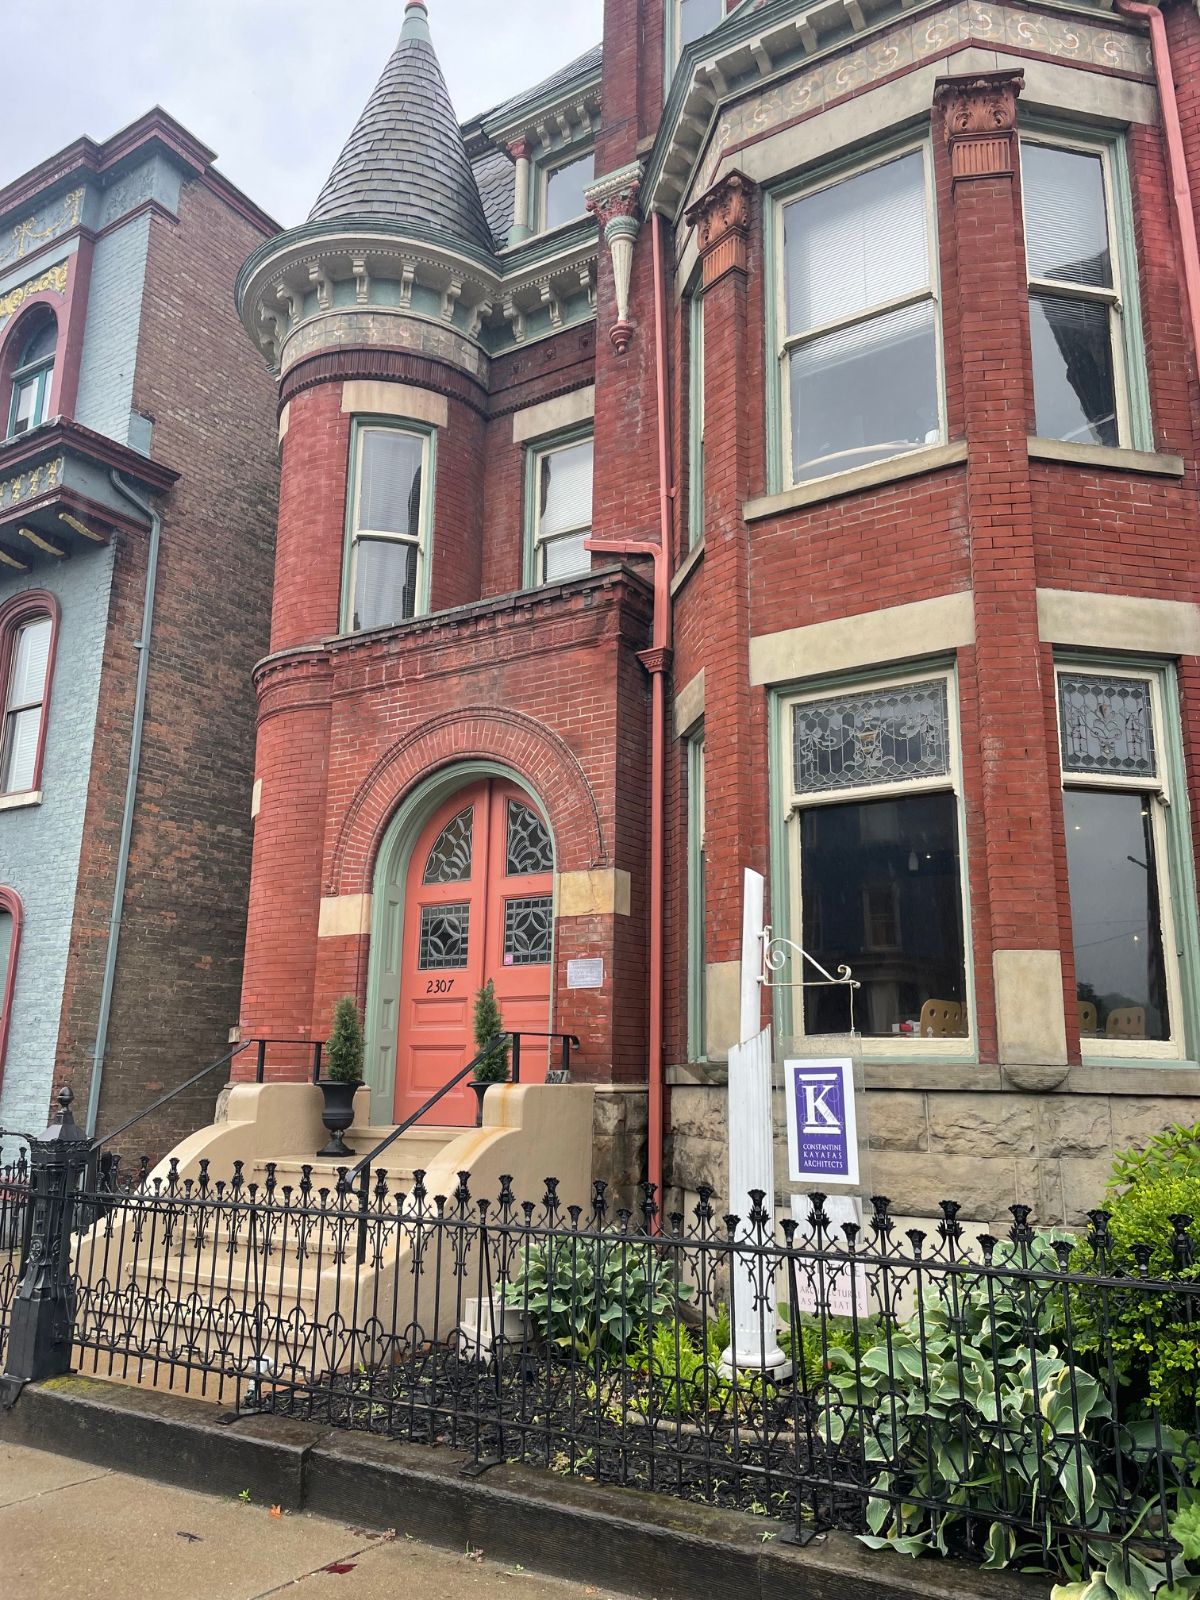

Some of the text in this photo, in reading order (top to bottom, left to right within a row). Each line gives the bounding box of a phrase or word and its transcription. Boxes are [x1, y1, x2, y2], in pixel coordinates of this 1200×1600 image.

[426, 978, 455, 994] 2307
[801, 1085, 842, 1126] K
[802, 1143, 842, 1152] CONSTANTINE
[803, 1151, 842, 1160] KAYAFAS
[803, 1159, 843, 1169] ARCHITECTS
